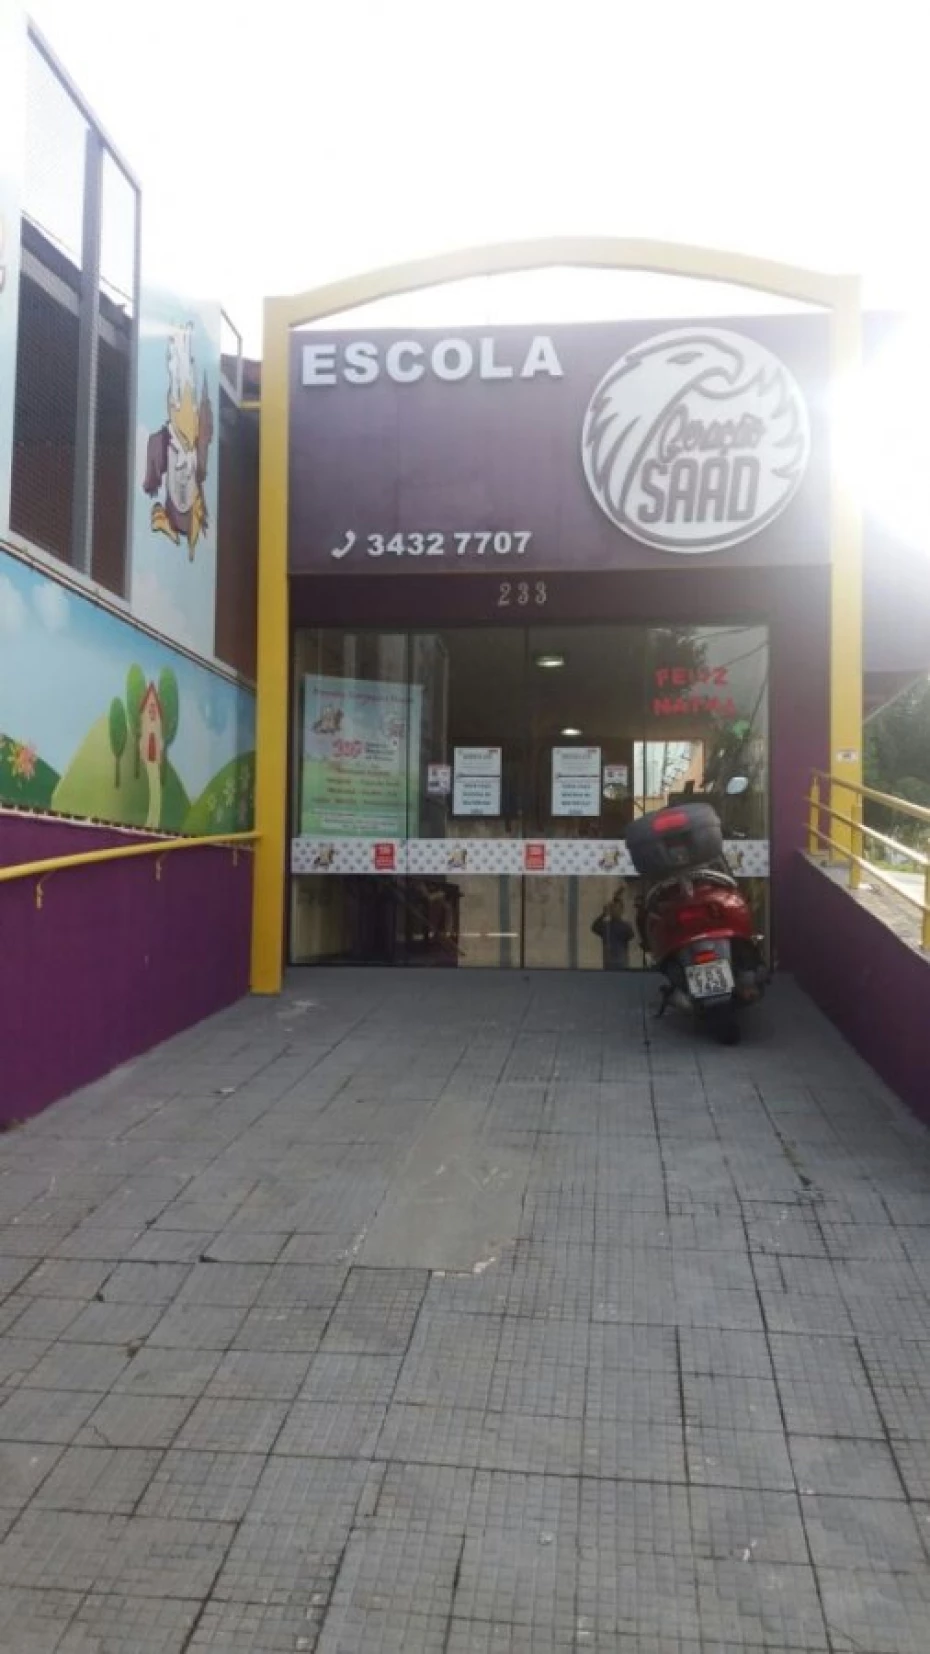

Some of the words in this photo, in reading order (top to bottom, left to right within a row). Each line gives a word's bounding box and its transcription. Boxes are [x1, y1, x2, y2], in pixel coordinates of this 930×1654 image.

[302, 335, 564, 386] ESCOLA
[638, 455, 761, 523] SAAD
[367, 532, 444, 556] 3432
[454, 531, 532, 555] 7707
[498, 581, 548, 608] 233
